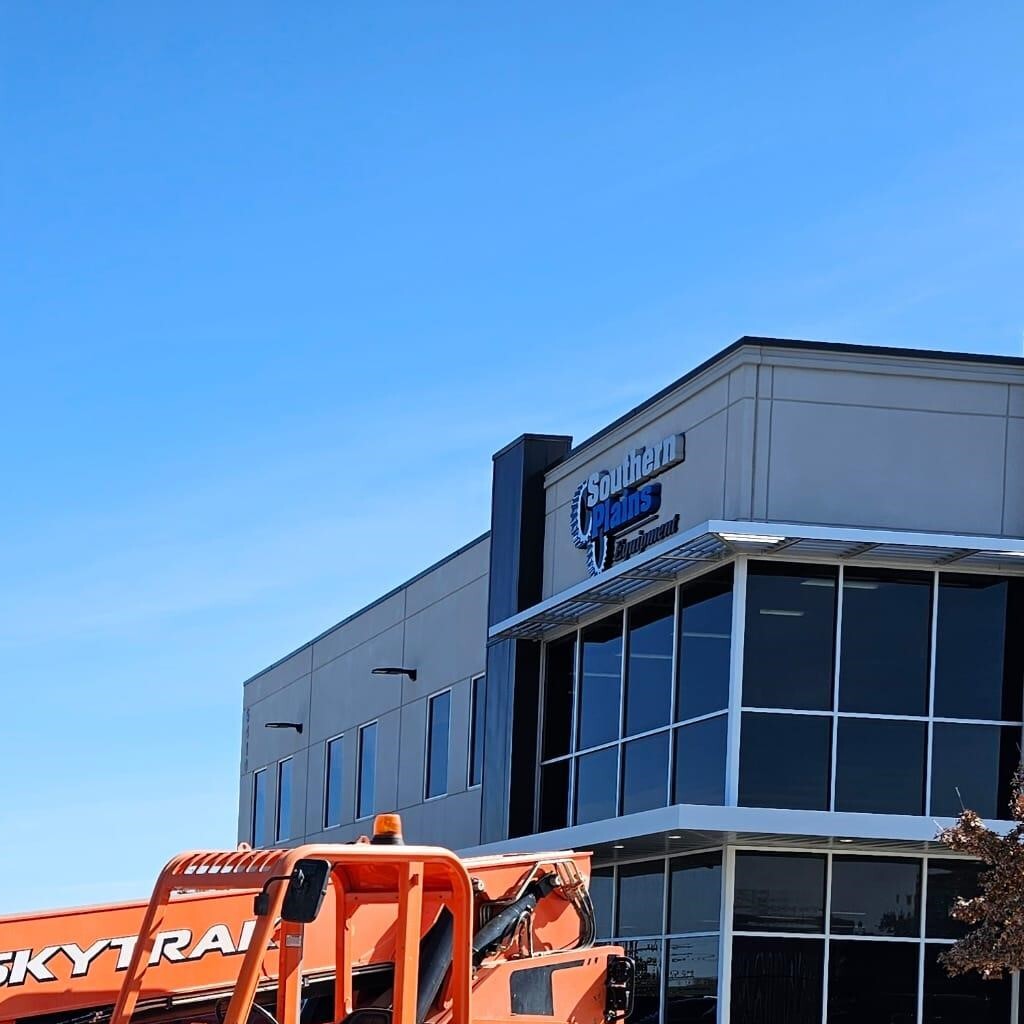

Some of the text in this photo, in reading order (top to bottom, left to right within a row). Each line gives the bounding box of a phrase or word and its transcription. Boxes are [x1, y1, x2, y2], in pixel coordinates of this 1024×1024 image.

[587, 434, 678, 507] Southern
[591, 484, 657, 538] Plains
[613, 514, 680, 561] Equipment
